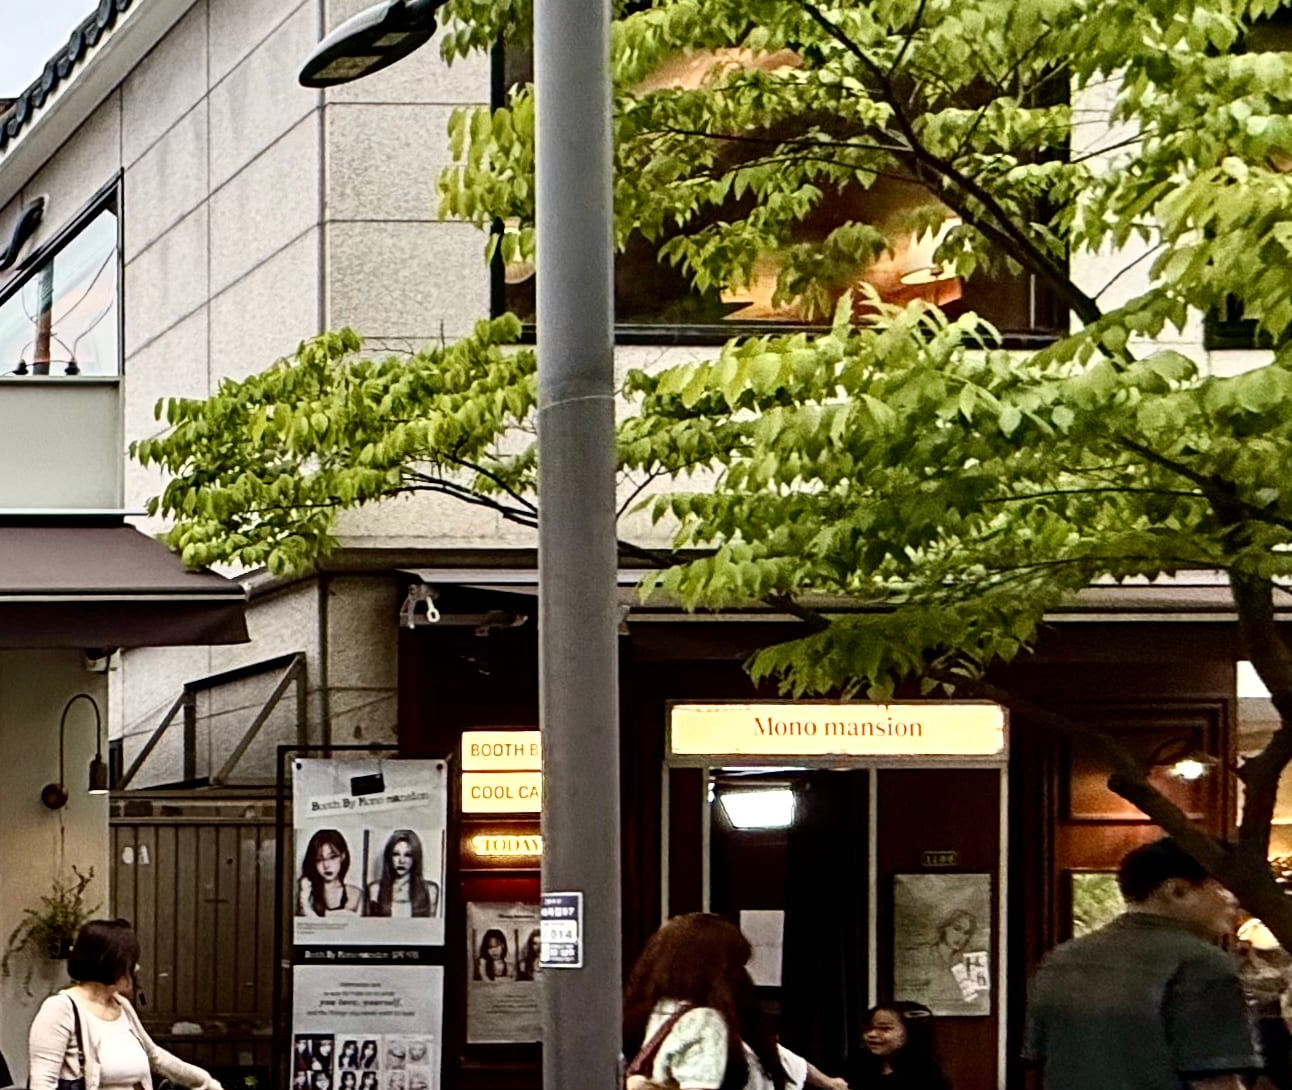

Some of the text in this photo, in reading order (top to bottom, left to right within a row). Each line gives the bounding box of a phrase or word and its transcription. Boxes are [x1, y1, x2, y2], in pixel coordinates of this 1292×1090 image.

[754, 717, 923, 737] Mono mansion
[471, 743, 524, 757] BOOTH
[471, 785, 514, 799] COOL
